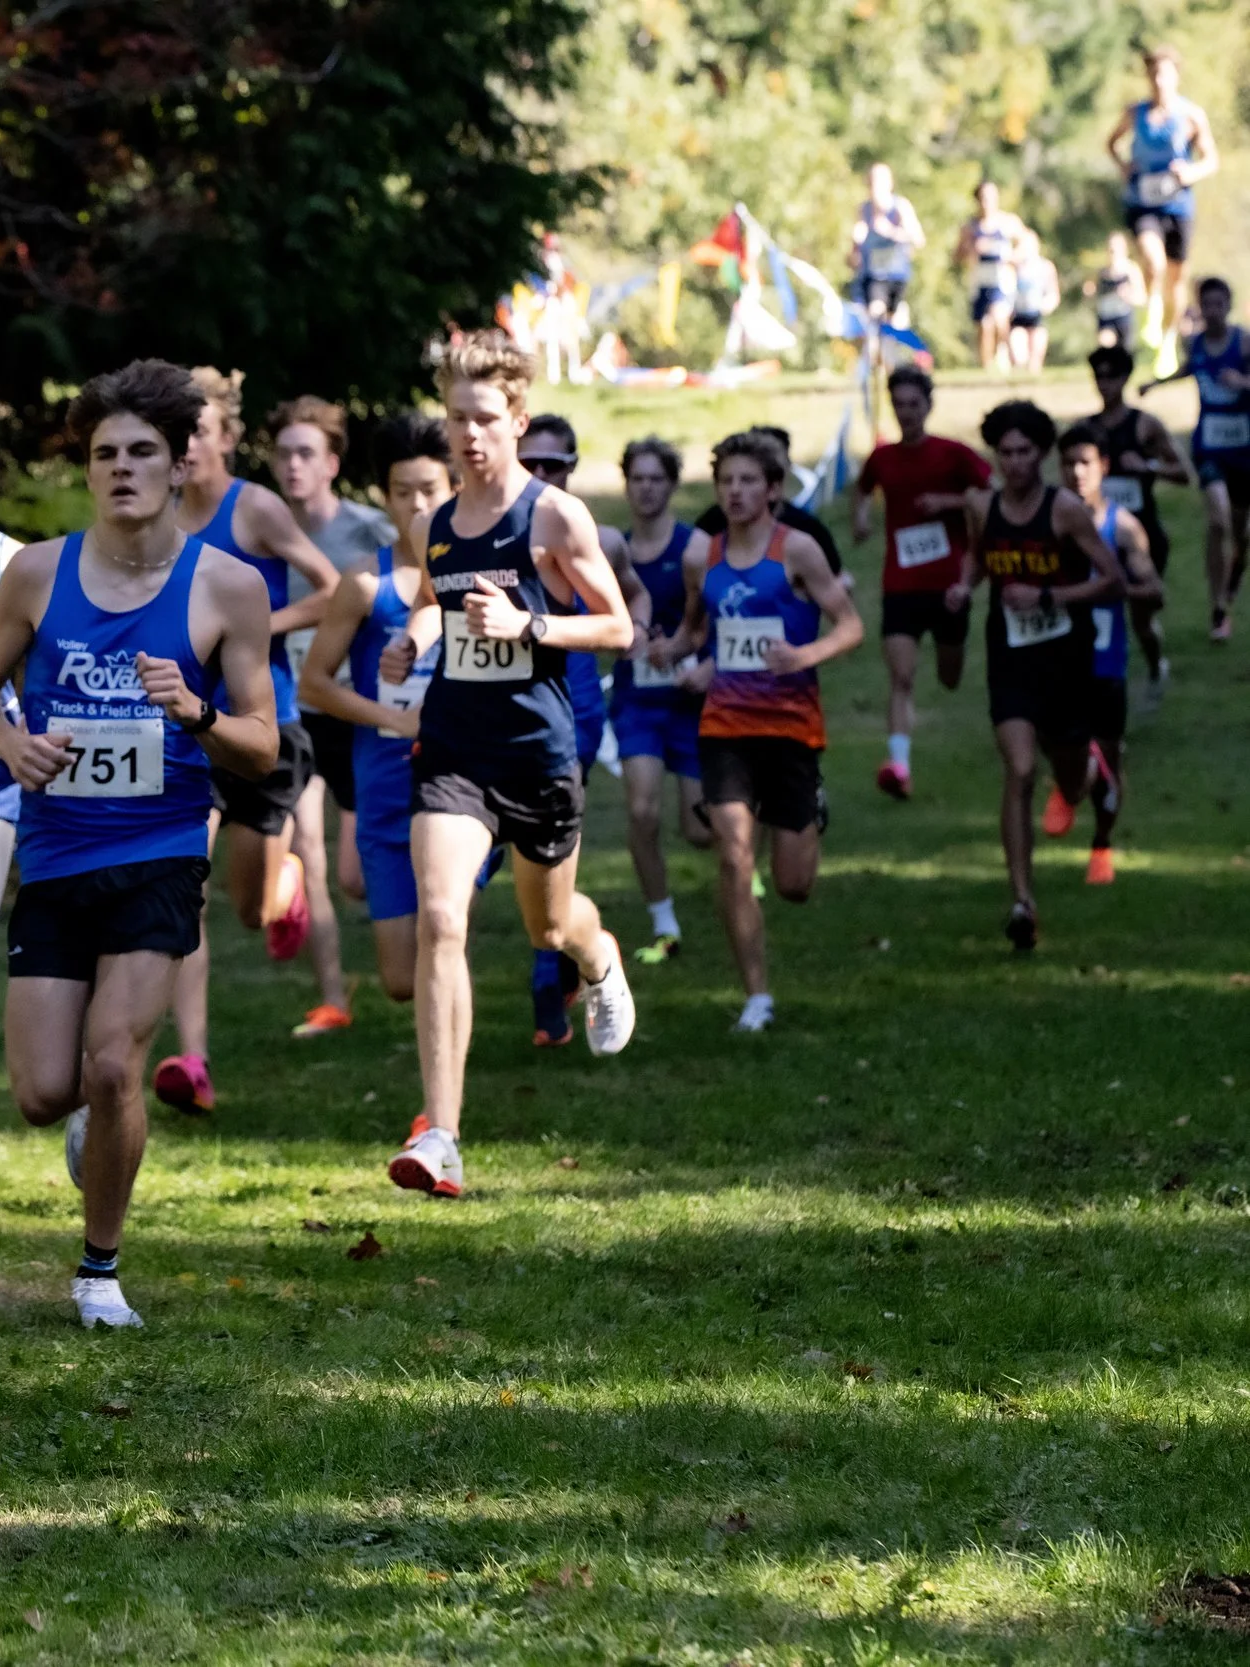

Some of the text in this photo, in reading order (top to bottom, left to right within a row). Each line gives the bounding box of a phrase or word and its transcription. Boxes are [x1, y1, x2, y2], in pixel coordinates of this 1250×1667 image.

[57, 638, 89, 652] Valley
[454, 637, 514, 669] 750
[51, 700, 165, 718] Track & Field Club
[64, 746, 138, 785] 751
